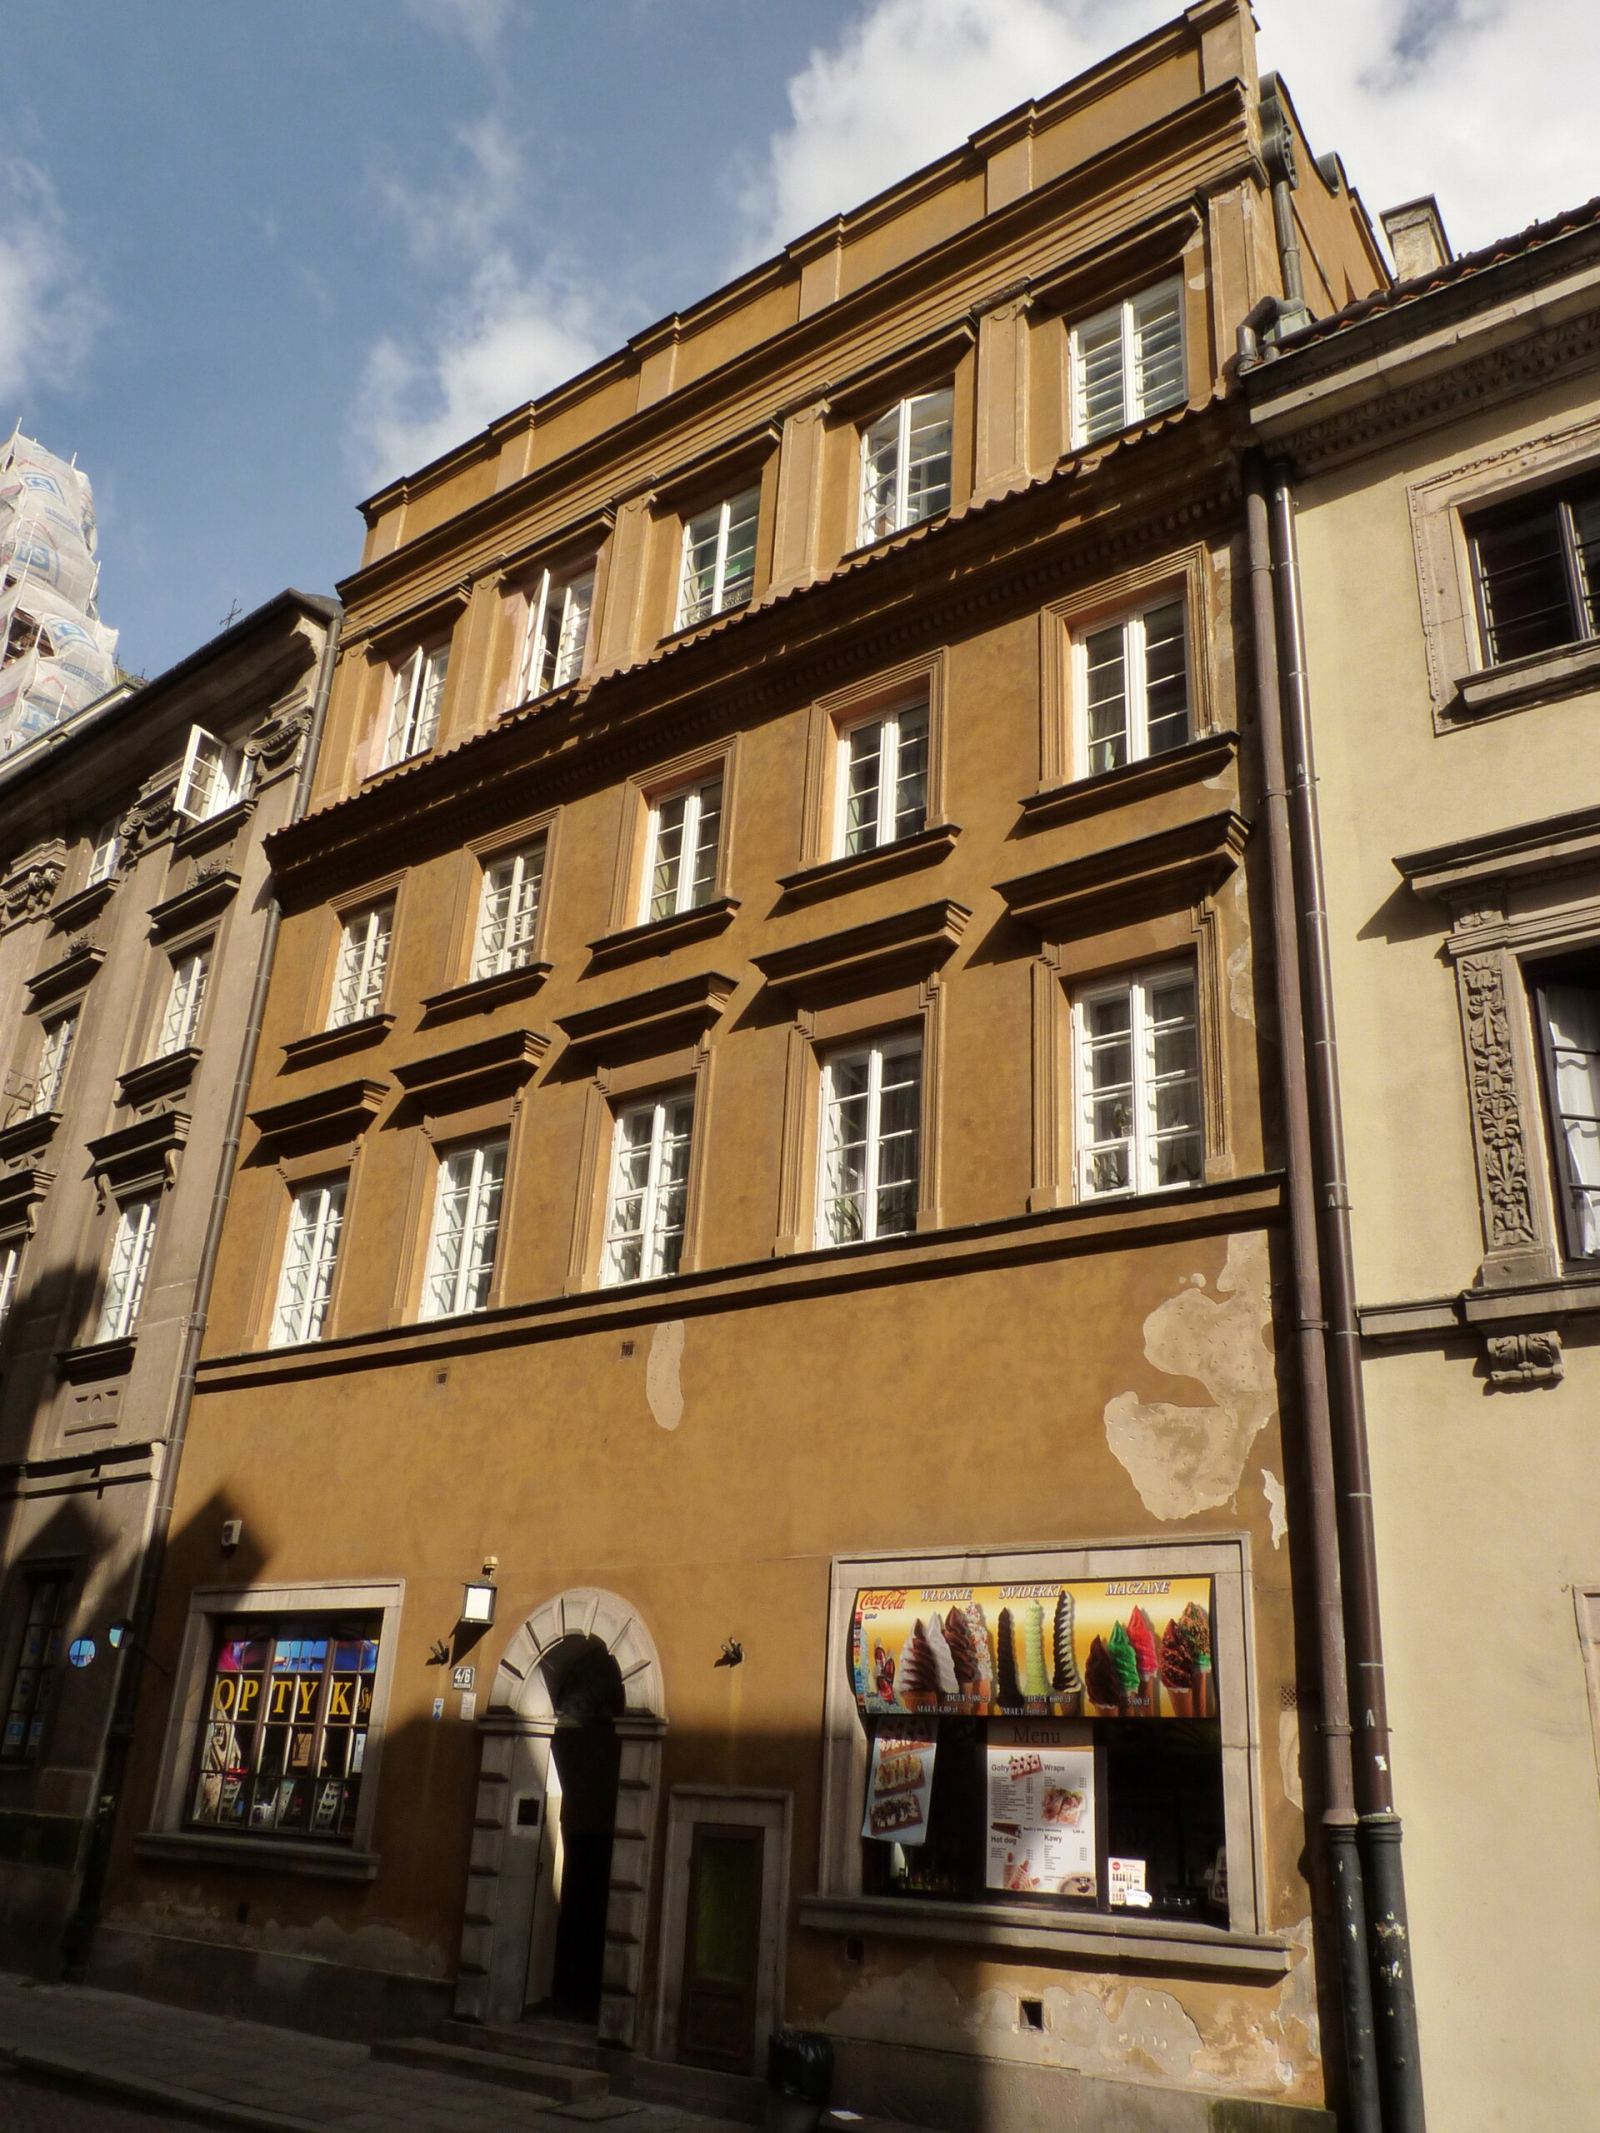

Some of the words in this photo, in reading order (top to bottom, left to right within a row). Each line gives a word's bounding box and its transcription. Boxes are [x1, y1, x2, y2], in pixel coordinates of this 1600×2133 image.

[1105, 1582, 1170, 1595] MACZANE
[454, 1668, 471, 1683] 4/6
[213, 1679, 352, 1715] OPTYK
[1013, 1726, 1060, 1744] Menu
[991, 1763, 1009, 1773] Gofry
[1044, 1763, 1065, 1773] Wraps
[990, 1835, 1003, 1844] Hot
[1004, 1836, 1017, 1846] dog
[1043, 1834, 1063, 1845] Kawy
